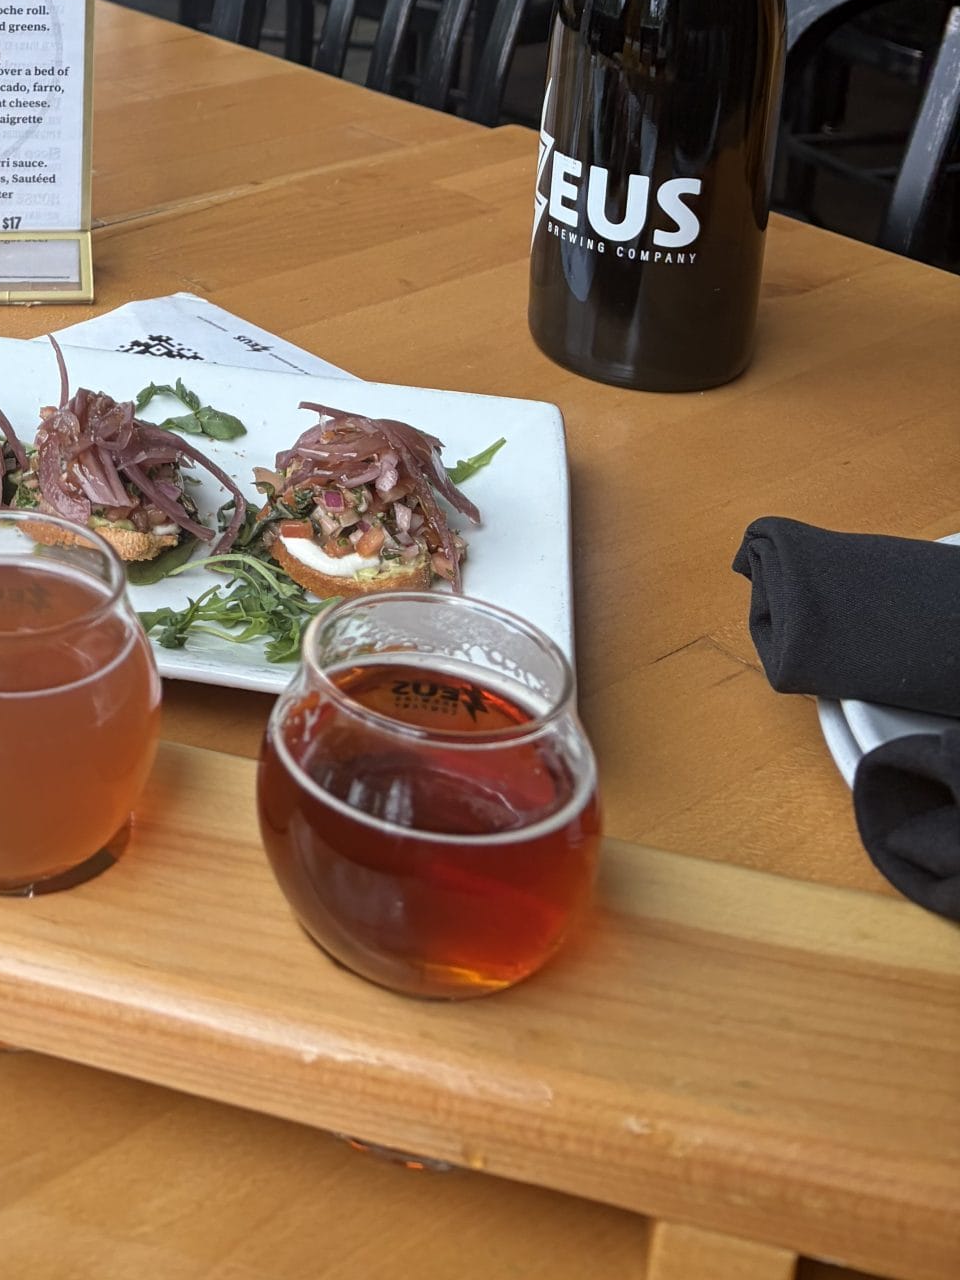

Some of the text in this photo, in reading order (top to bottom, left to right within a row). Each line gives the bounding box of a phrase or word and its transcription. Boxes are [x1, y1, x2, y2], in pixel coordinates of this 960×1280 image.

[25, 4, 50, 16] roll.
[7, 23, 51, 35] greens.
[24, 68, 33, 77] a
[33, 65, 56, 77] bed
[56, 65, 71, 77] of
[32, 81, 66, 95] farro,
[8, 97, 51, 109] cheese.
[11, 160, 49, 169] sauce.
[11, 172, 57, 185] Sautéed
[1, 215, 23, 231] $17
[547, 221, 698, 265] BREWING COMPANY
